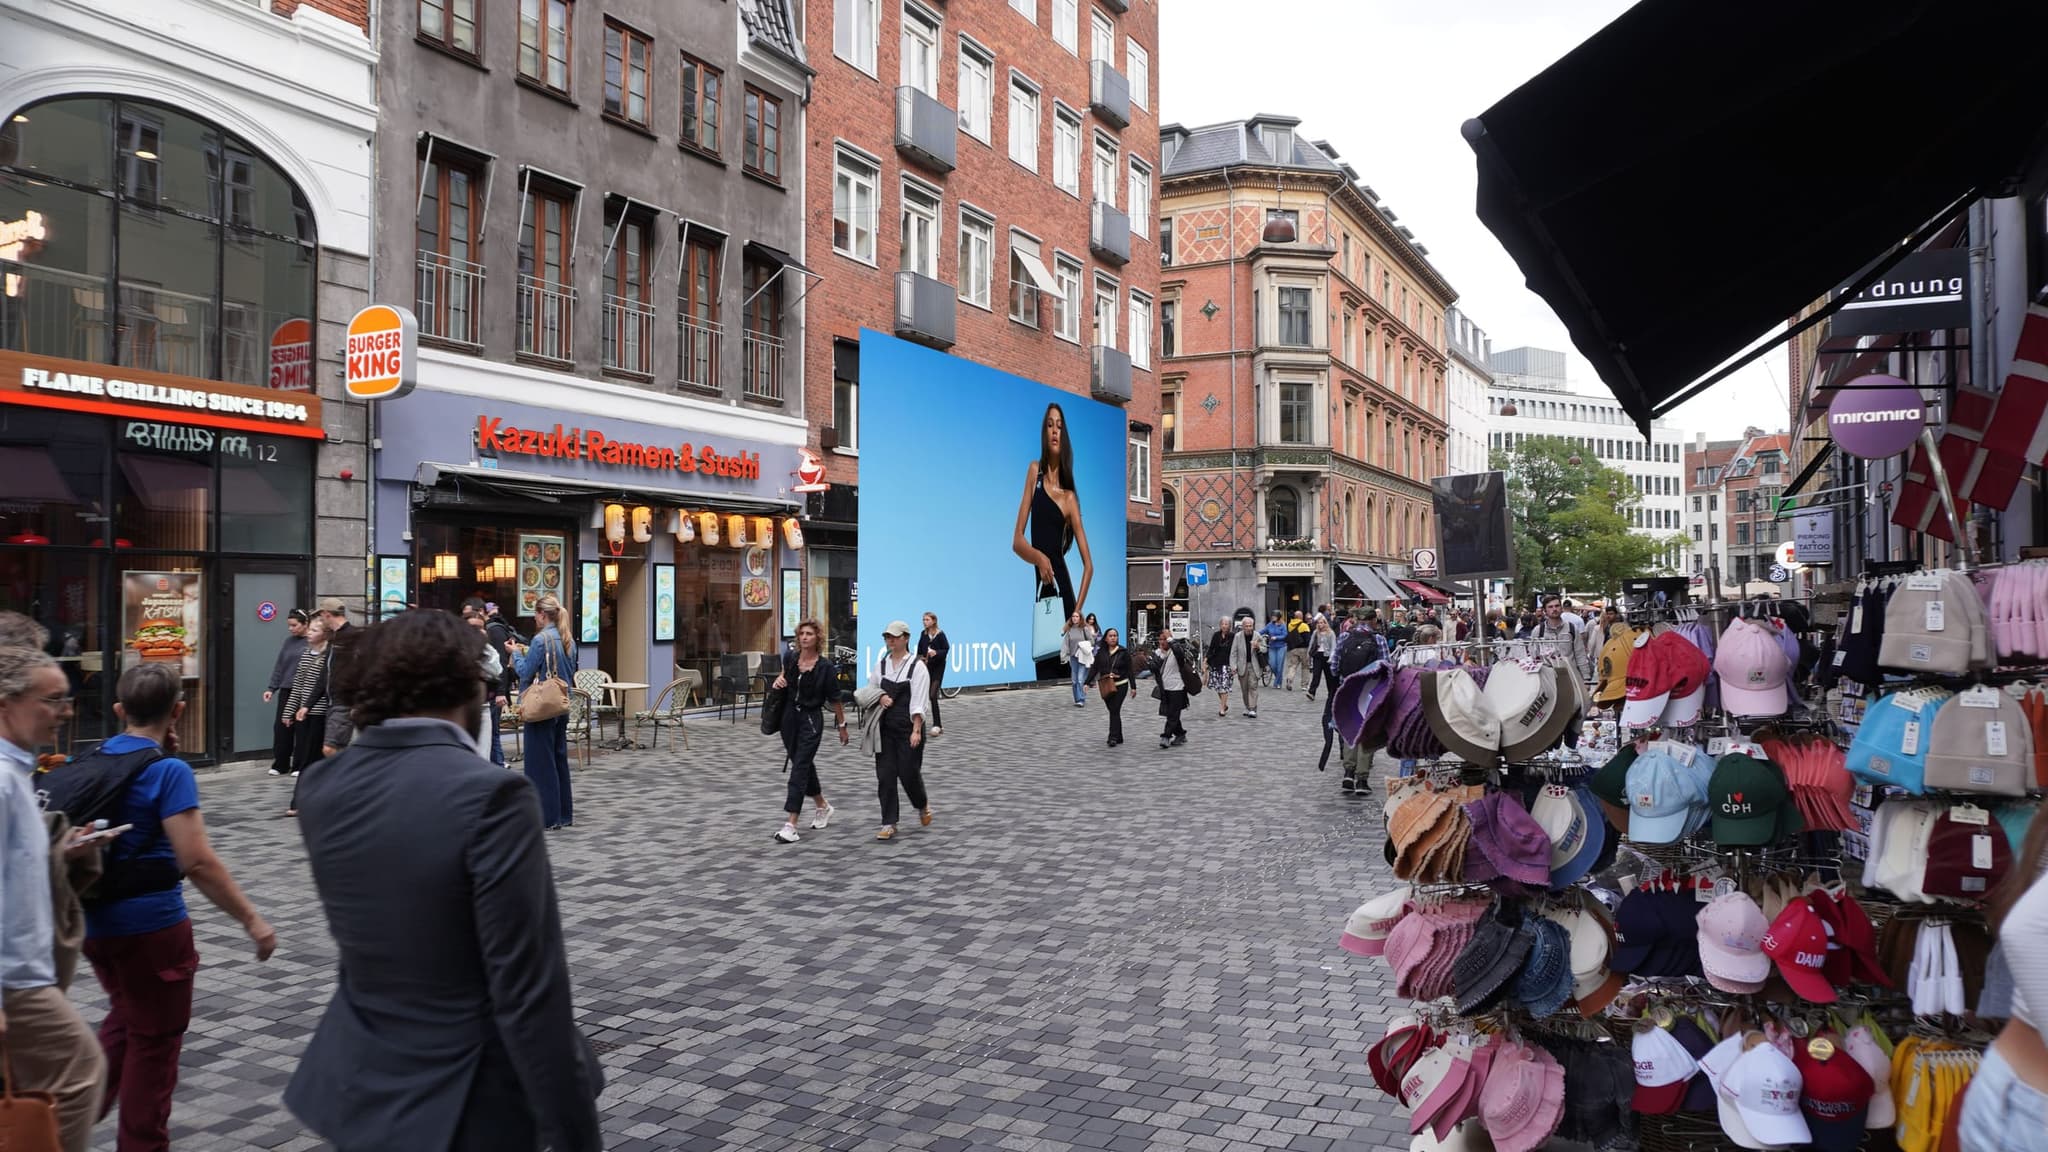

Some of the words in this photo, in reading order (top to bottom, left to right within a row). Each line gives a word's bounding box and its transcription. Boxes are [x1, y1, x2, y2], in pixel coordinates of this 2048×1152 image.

[348, 331, 401, 355] BURGER
[348, 350, 401, 380] KING
[21, 367, 105, 396] FLAME
[106, 379, 207, 410] GRILLING
[207, 392, 266, 416] SINCE
[266, 400, 309, 422] 1954
[1832, 408, 1921, 425] miramira
[257, 444, 278, 463] 12
[477, 415, 581, 461] Kazuki
[587, 429, 675, 471] Ramen
[679, 442, 697, 473] &
[700, 445, 761, 481] Sushi
[950, 641, 1017, 673] UITTON
[1721, 802, 1752, 815] CPH
[1727, 793, 1732, 804] I
[1633, 1060, 1654, 1070] GGE
